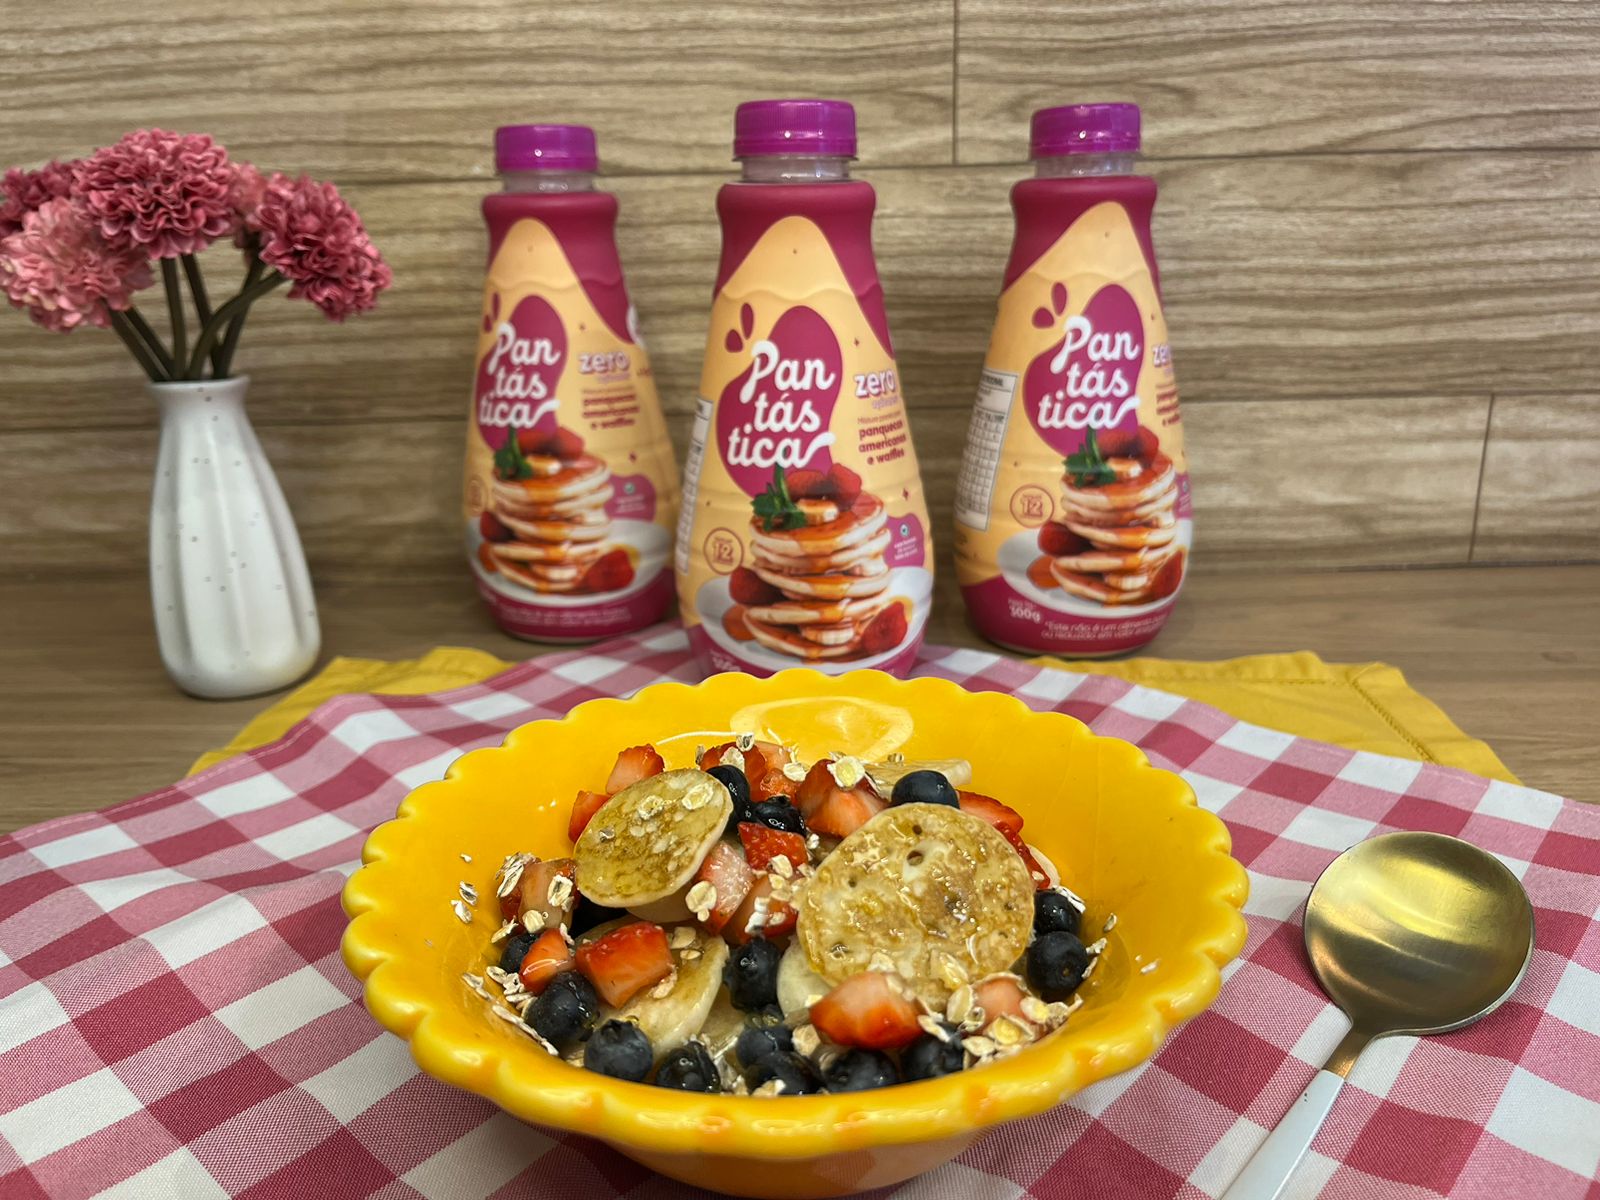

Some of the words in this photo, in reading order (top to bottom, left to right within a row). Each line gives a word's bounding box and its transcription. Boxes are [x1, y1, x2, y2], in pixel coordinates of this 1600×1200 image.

[487, 321, 561, 376] Pan
[579, 351, 630, 374] zero
[1050, 315, 1140, 374] Pan
[495, 365, 547, 399] tás
[740, 340, 836, 404] Pan
[854, 369, 896, 399] zero
[1066, 362, 1129, 398] tás
[479, 391, 560, 428] tica
[754, 392, 821, 432] tás
[1037, 391, 1140, 429] tica
[727, 424, 836, 468] tica
